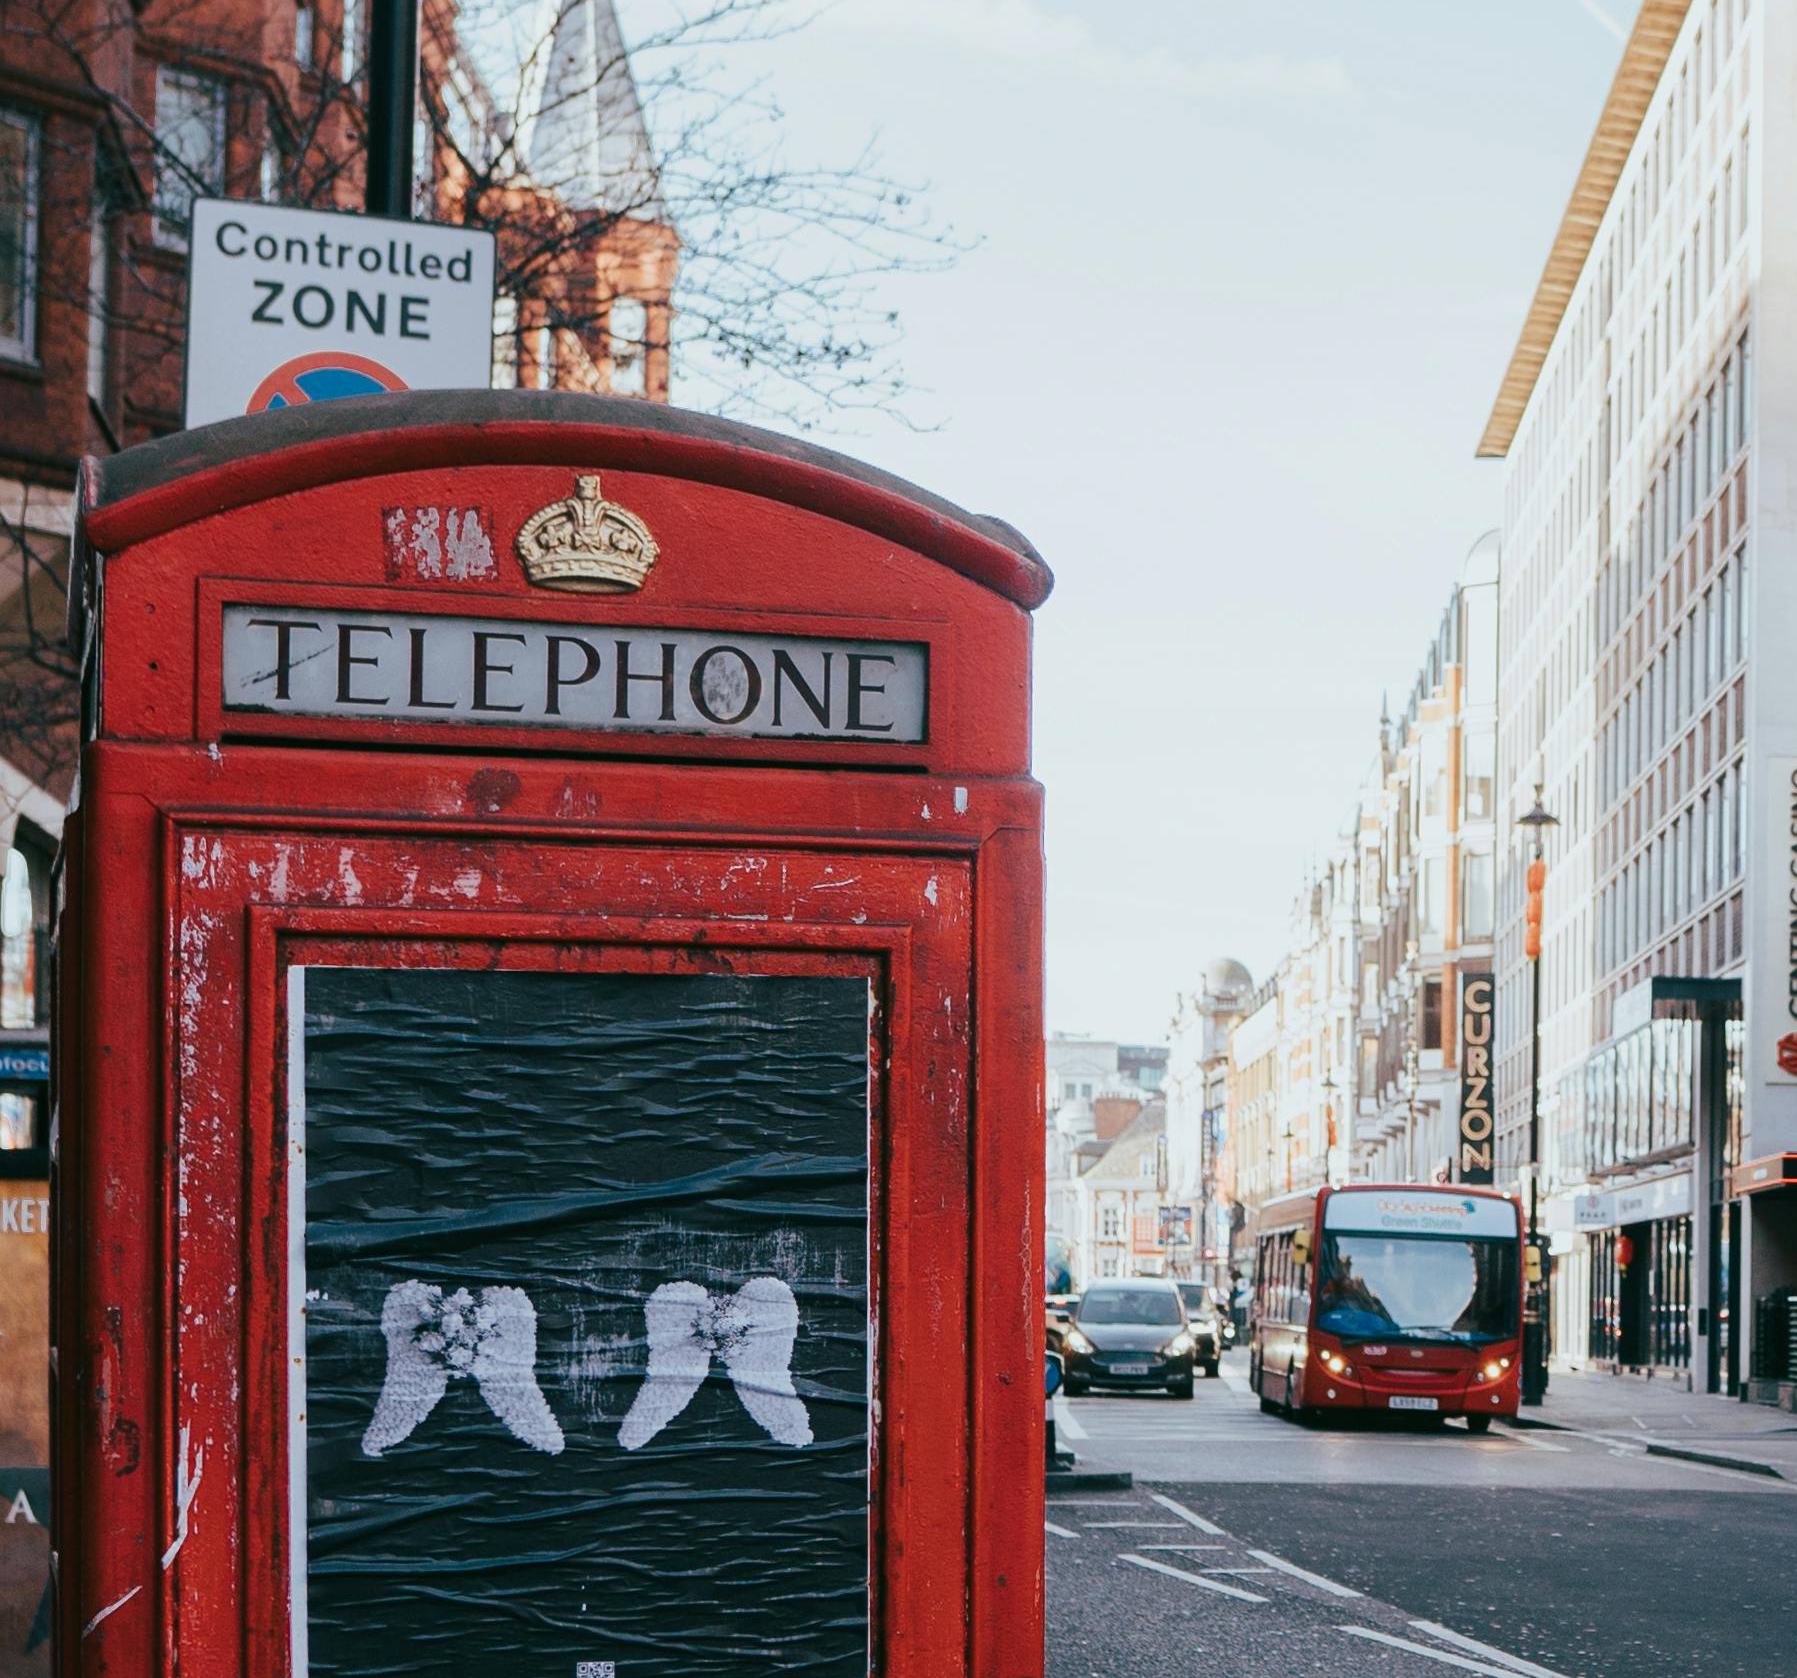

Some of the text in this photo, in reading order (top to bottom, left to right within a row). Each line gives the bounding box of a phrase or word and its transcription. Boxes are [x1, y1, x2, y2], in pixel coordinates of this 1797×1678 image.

[215, 221, 473, 283] Controlled
[251, 279, 431, 341] ZONE
[247, 617, 896, 732] TELEPHONE
[1460, 980, 1494, 1172] CURZON
